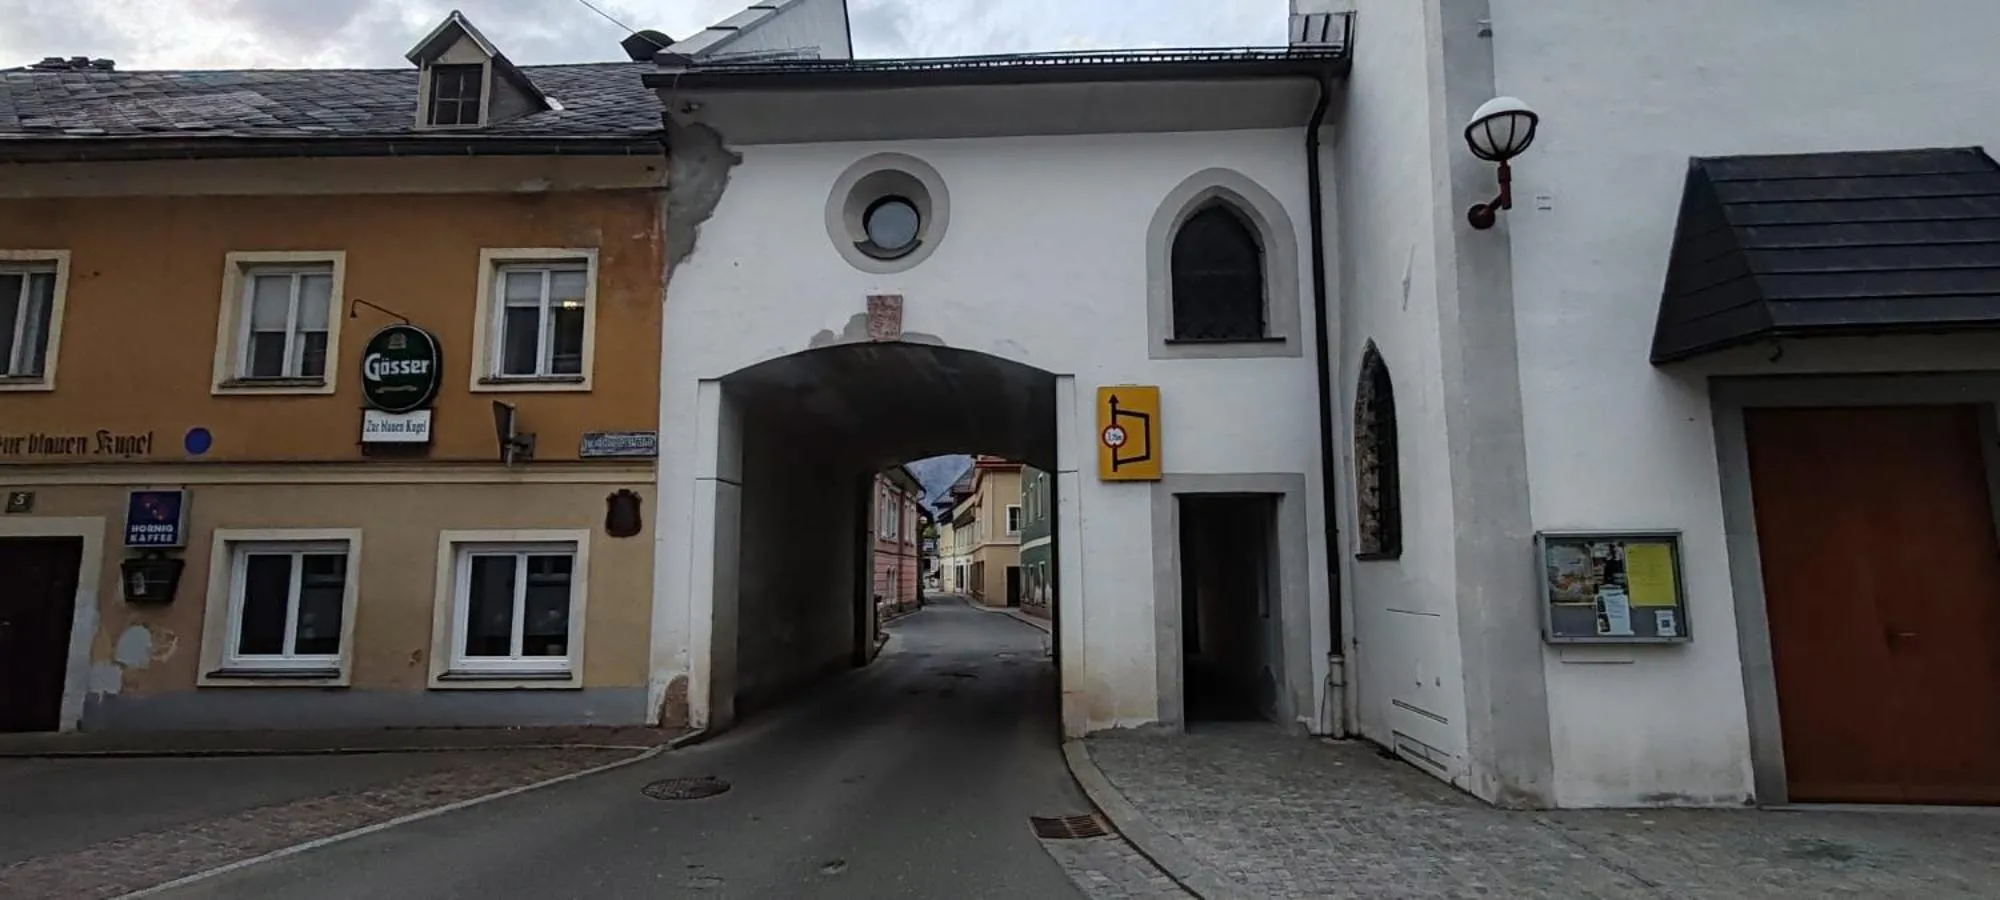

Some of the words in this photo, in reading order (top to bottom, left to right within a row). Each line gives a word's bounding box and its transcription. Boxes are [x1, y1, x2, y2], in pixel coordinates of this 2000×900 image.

[364, 352, 429, 381] Gösser
[366, 419, 379, 432] Zur
[405, 419, 427, 434] Kugel
[27, 431, 88, 455] blauen
[94, 428, 153, 458] Kugel
[14, 493, 27, 505] 5
[131, 524, 174, 533] HORNIG
[129, 533, 173, 543] KAFFEE
